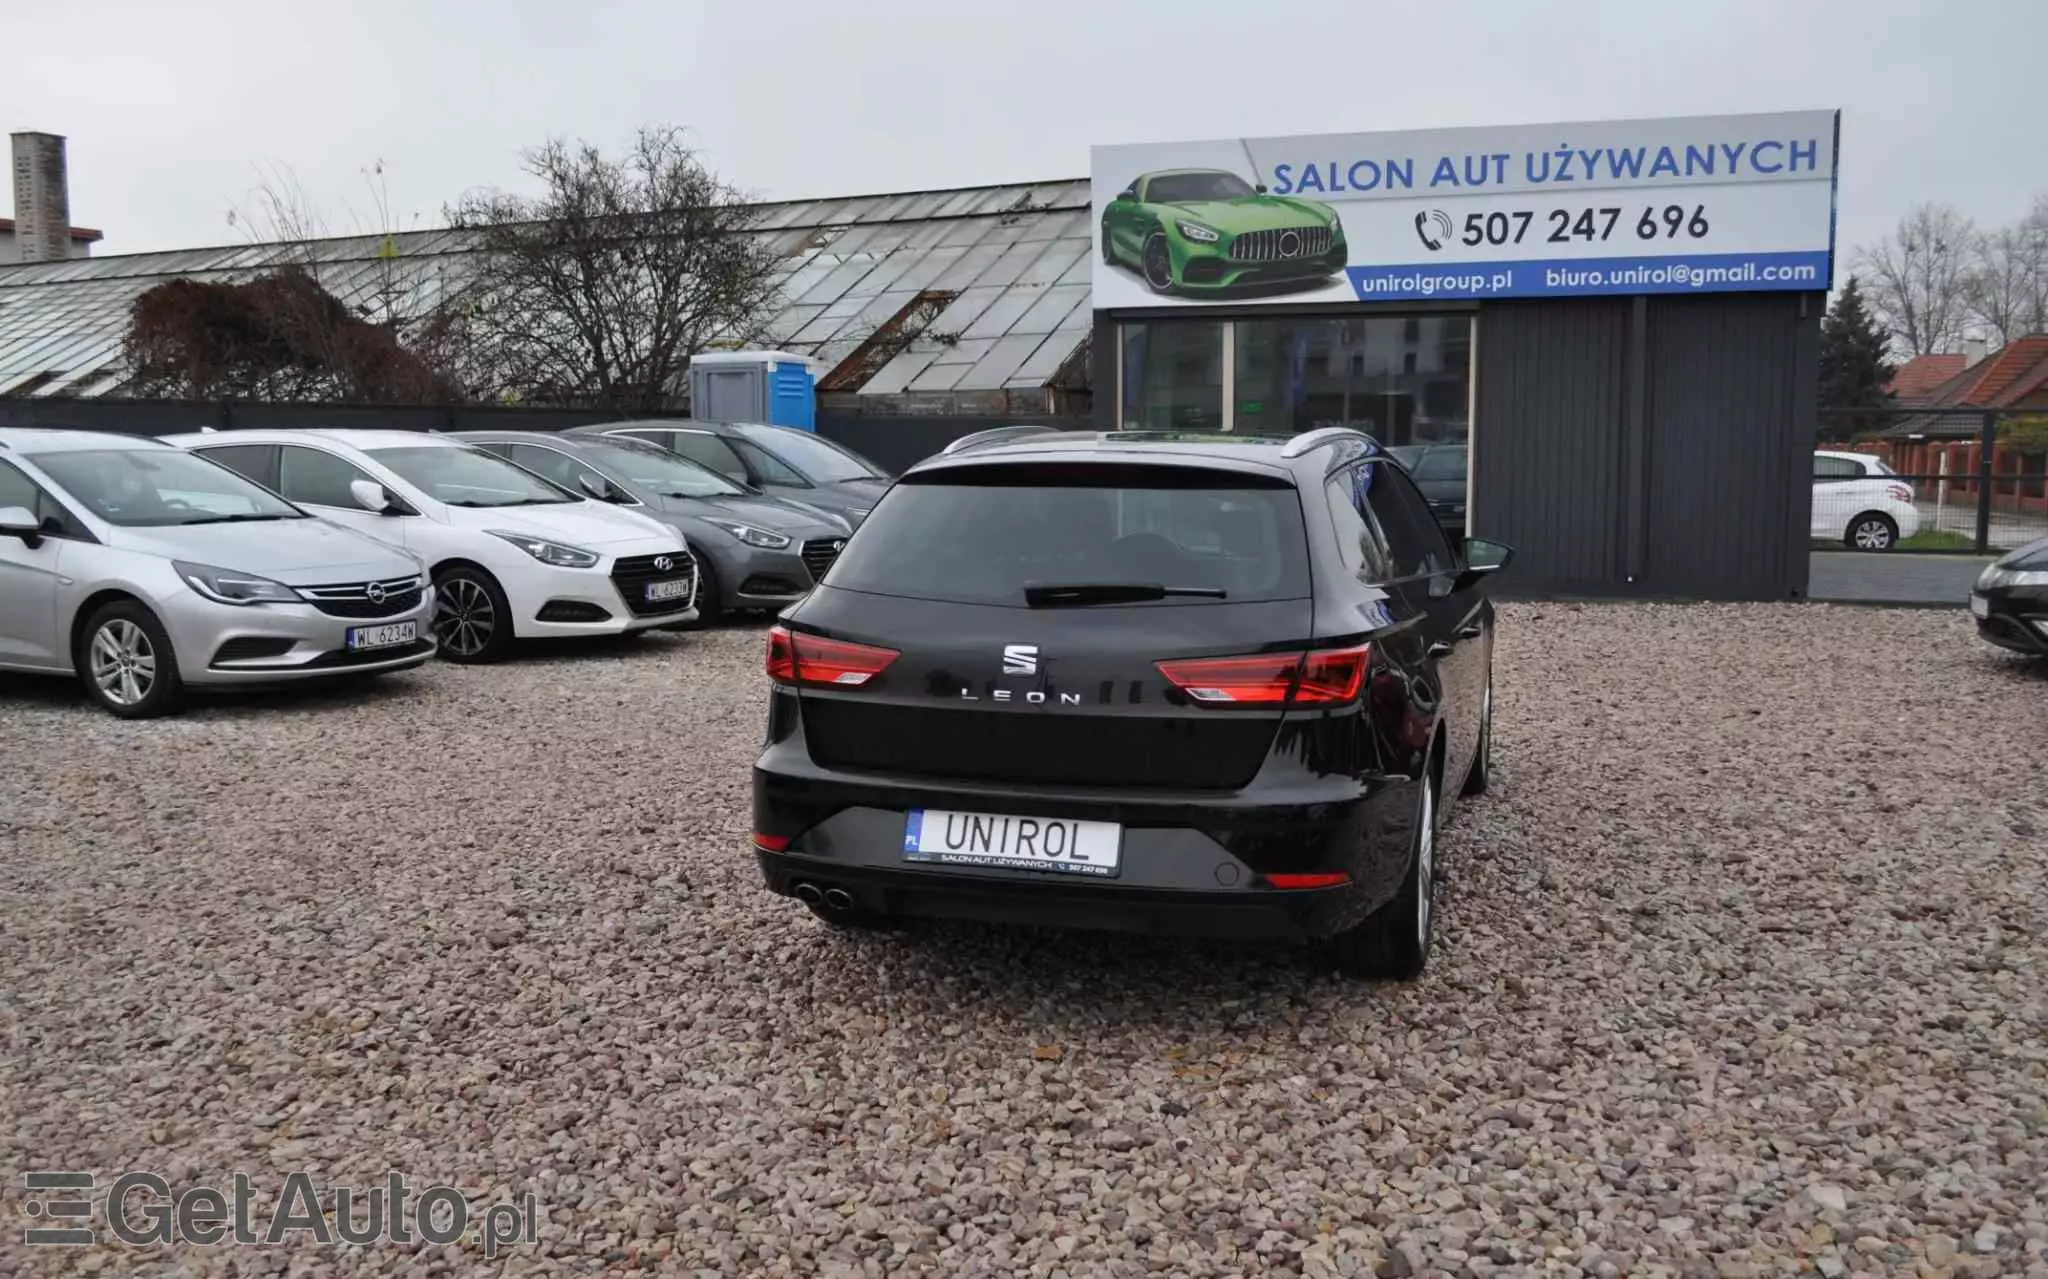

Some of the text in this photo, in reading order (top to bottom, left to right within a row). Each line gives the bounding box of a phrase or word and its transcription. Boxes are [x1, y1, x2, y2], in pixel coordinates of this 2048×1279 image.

[1273, 139, 1817, 195] SALON AUT UŻYWANYCH
[1461, 204, 1709, 246] 507 247 696
[1362, 262, 1816, 295] unirolgroup.pl biuro.unirol@gmail.com
[357, 622, 415, 647] WL 6234W
[961, 688, 1081, 706] LEON
[904, 834, 919, 846] PL
[944, 813, 1090, 861] UNIROL
[940, 853, 971, 864] SALON
[971, 856, 992, 866] AUT
